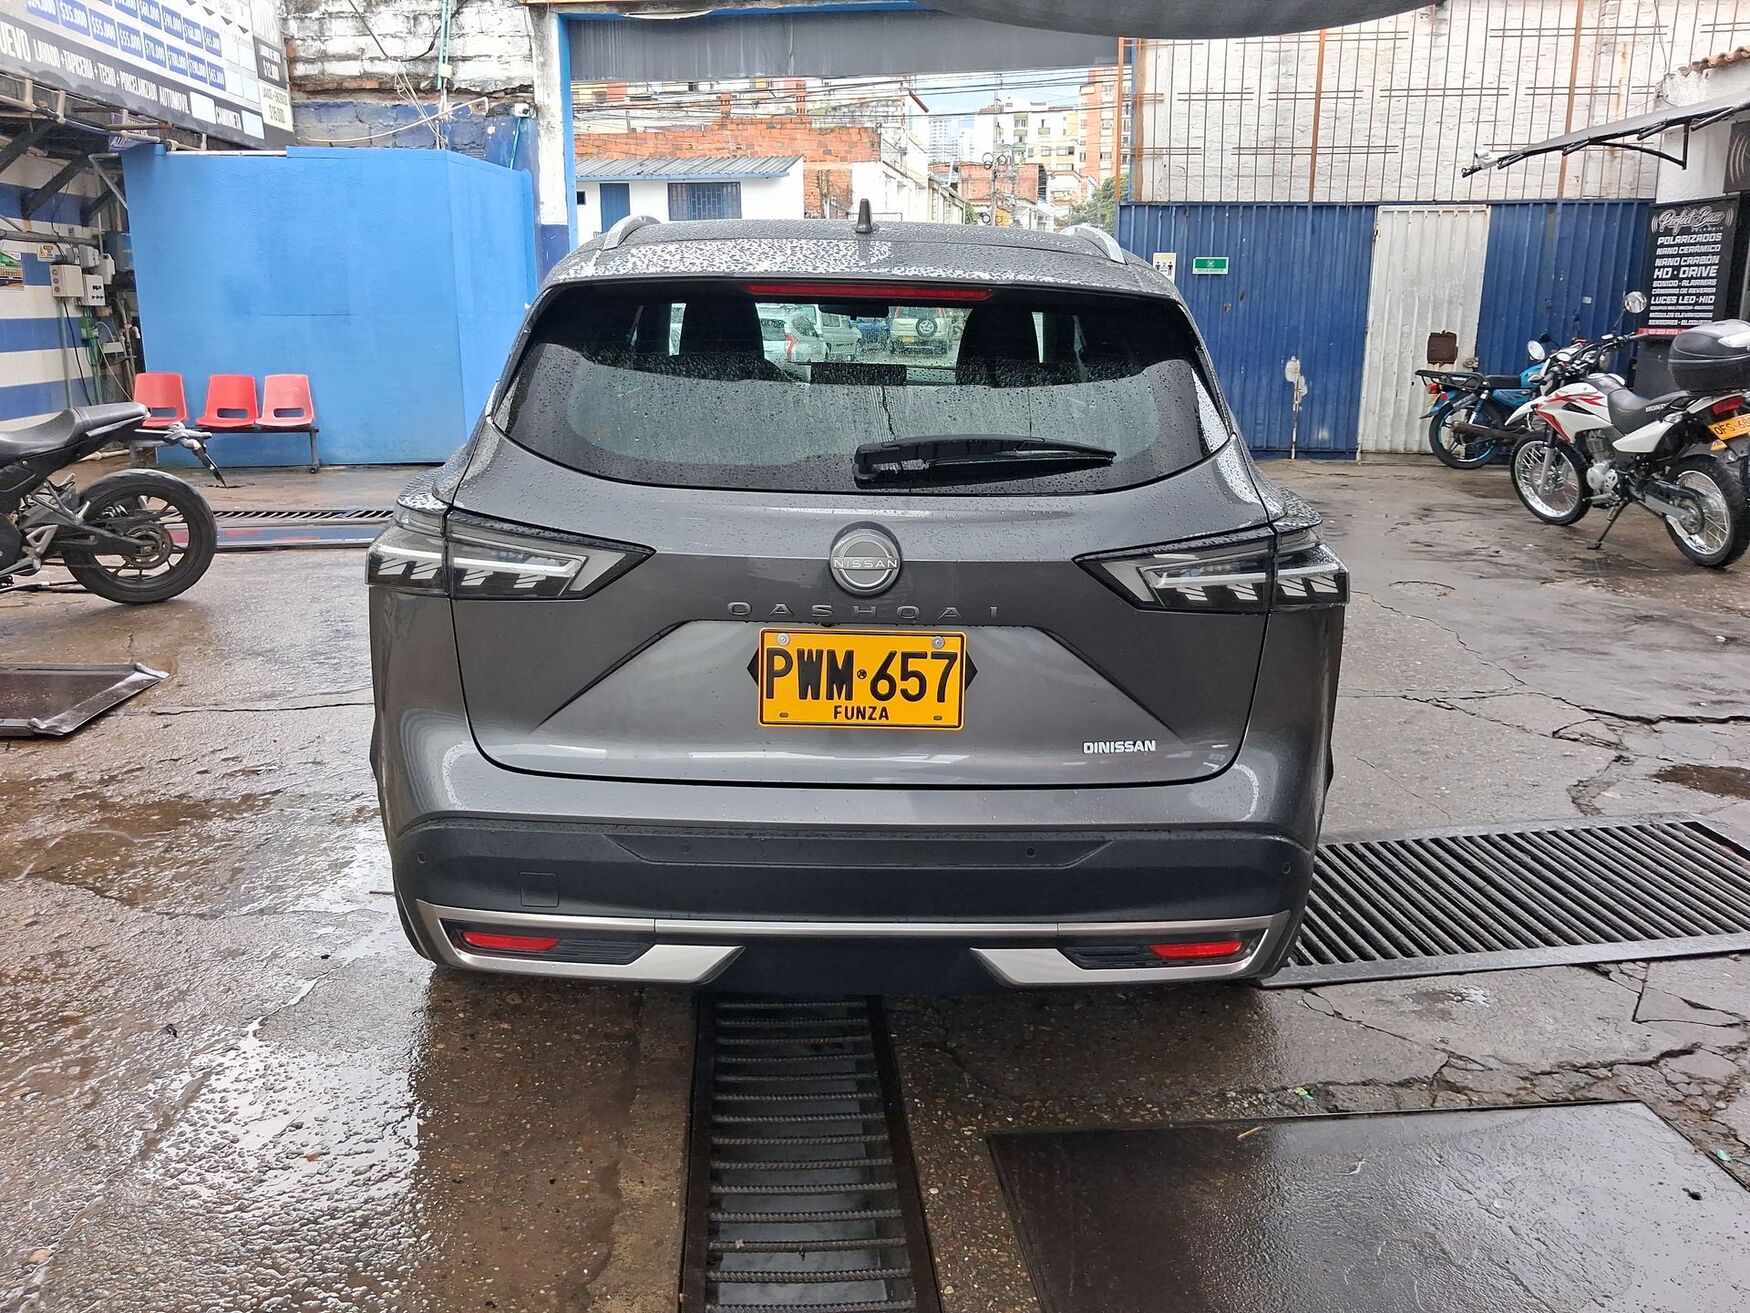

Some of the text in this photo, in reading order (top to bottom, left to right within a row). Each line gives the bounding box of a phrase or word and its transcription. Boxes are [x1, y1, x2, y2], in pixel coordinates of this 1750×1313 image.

[1657, 233, 1722, 245] POLARIZADOS
[1656, 247, 1678, 255] NANO
[1655, 257, 1680, 267] NANO
[1654, 266, 1718, 279] HD DRIVE
[1651, 296, 1677, 304] LUCES
[1645, 403, 1669, 412] HOND
[833, 558, 898, 569] NISSAN
[727, 601, 998, 621] QASHQAI
[833, 704, 890, 721] FUNZA
[1083, 740, 1156, 754] DINISSAN
